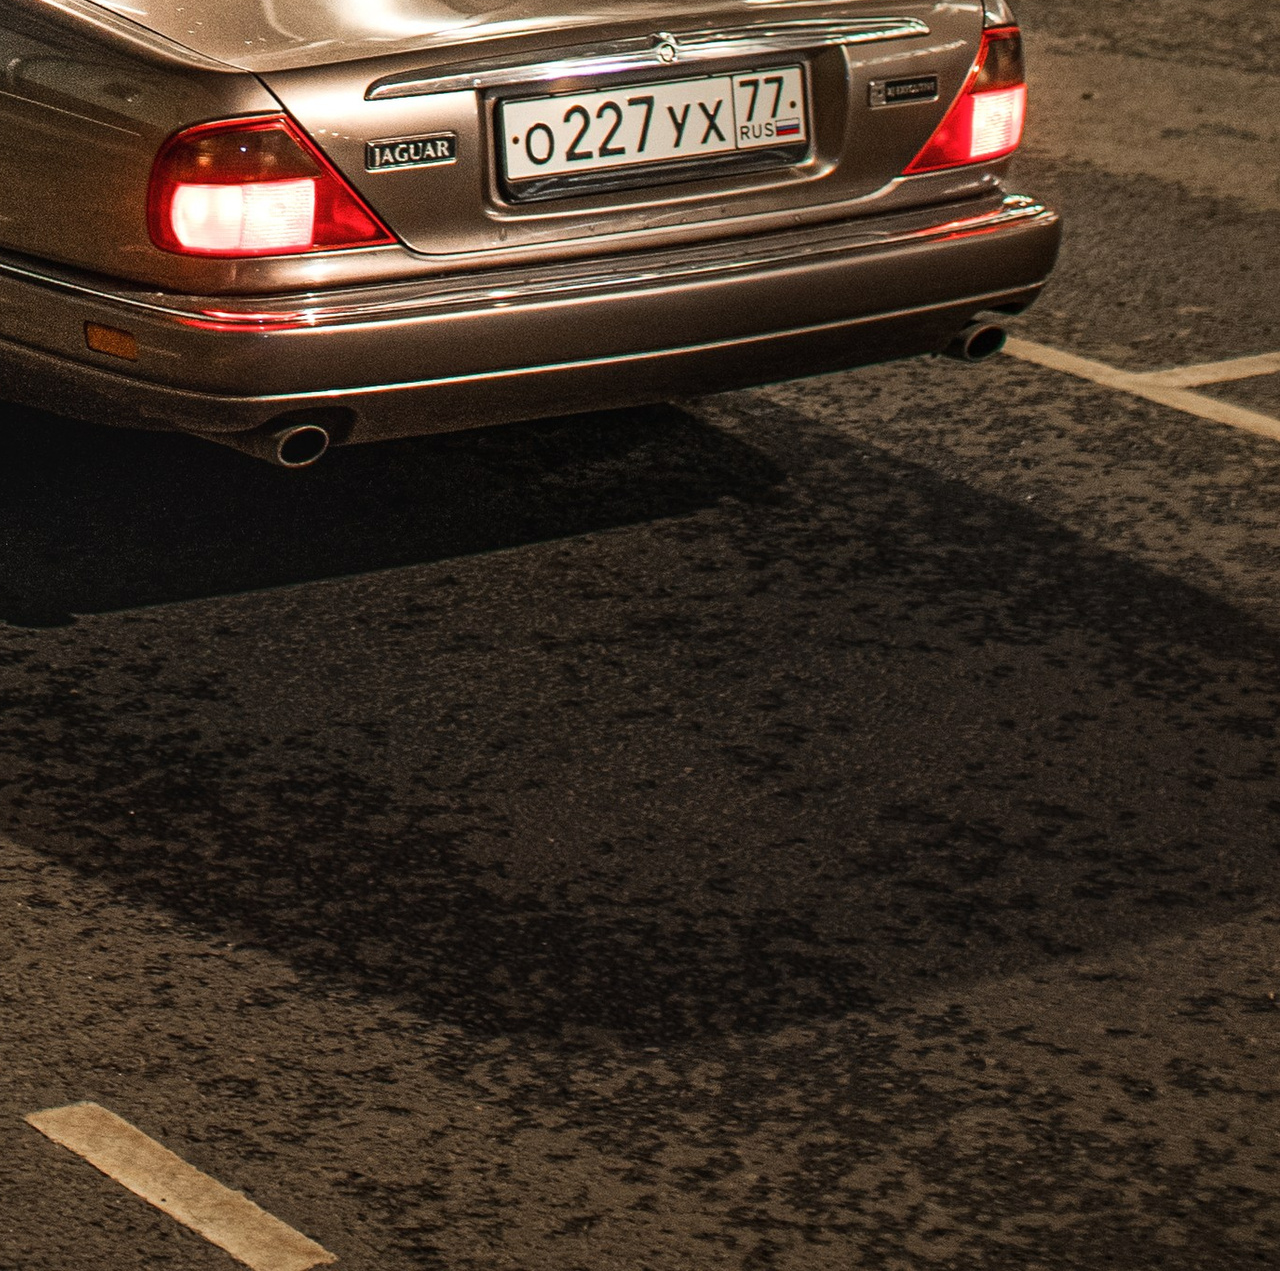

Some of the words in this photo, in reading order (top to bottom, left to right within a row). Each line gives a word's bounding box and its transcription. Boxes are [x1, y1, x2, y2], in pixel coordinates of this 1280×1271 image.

[738, 75, 784, 123] 77
[739, 121, 775, 141] RUS
[373, 139, 450, 167] JAGUAR
